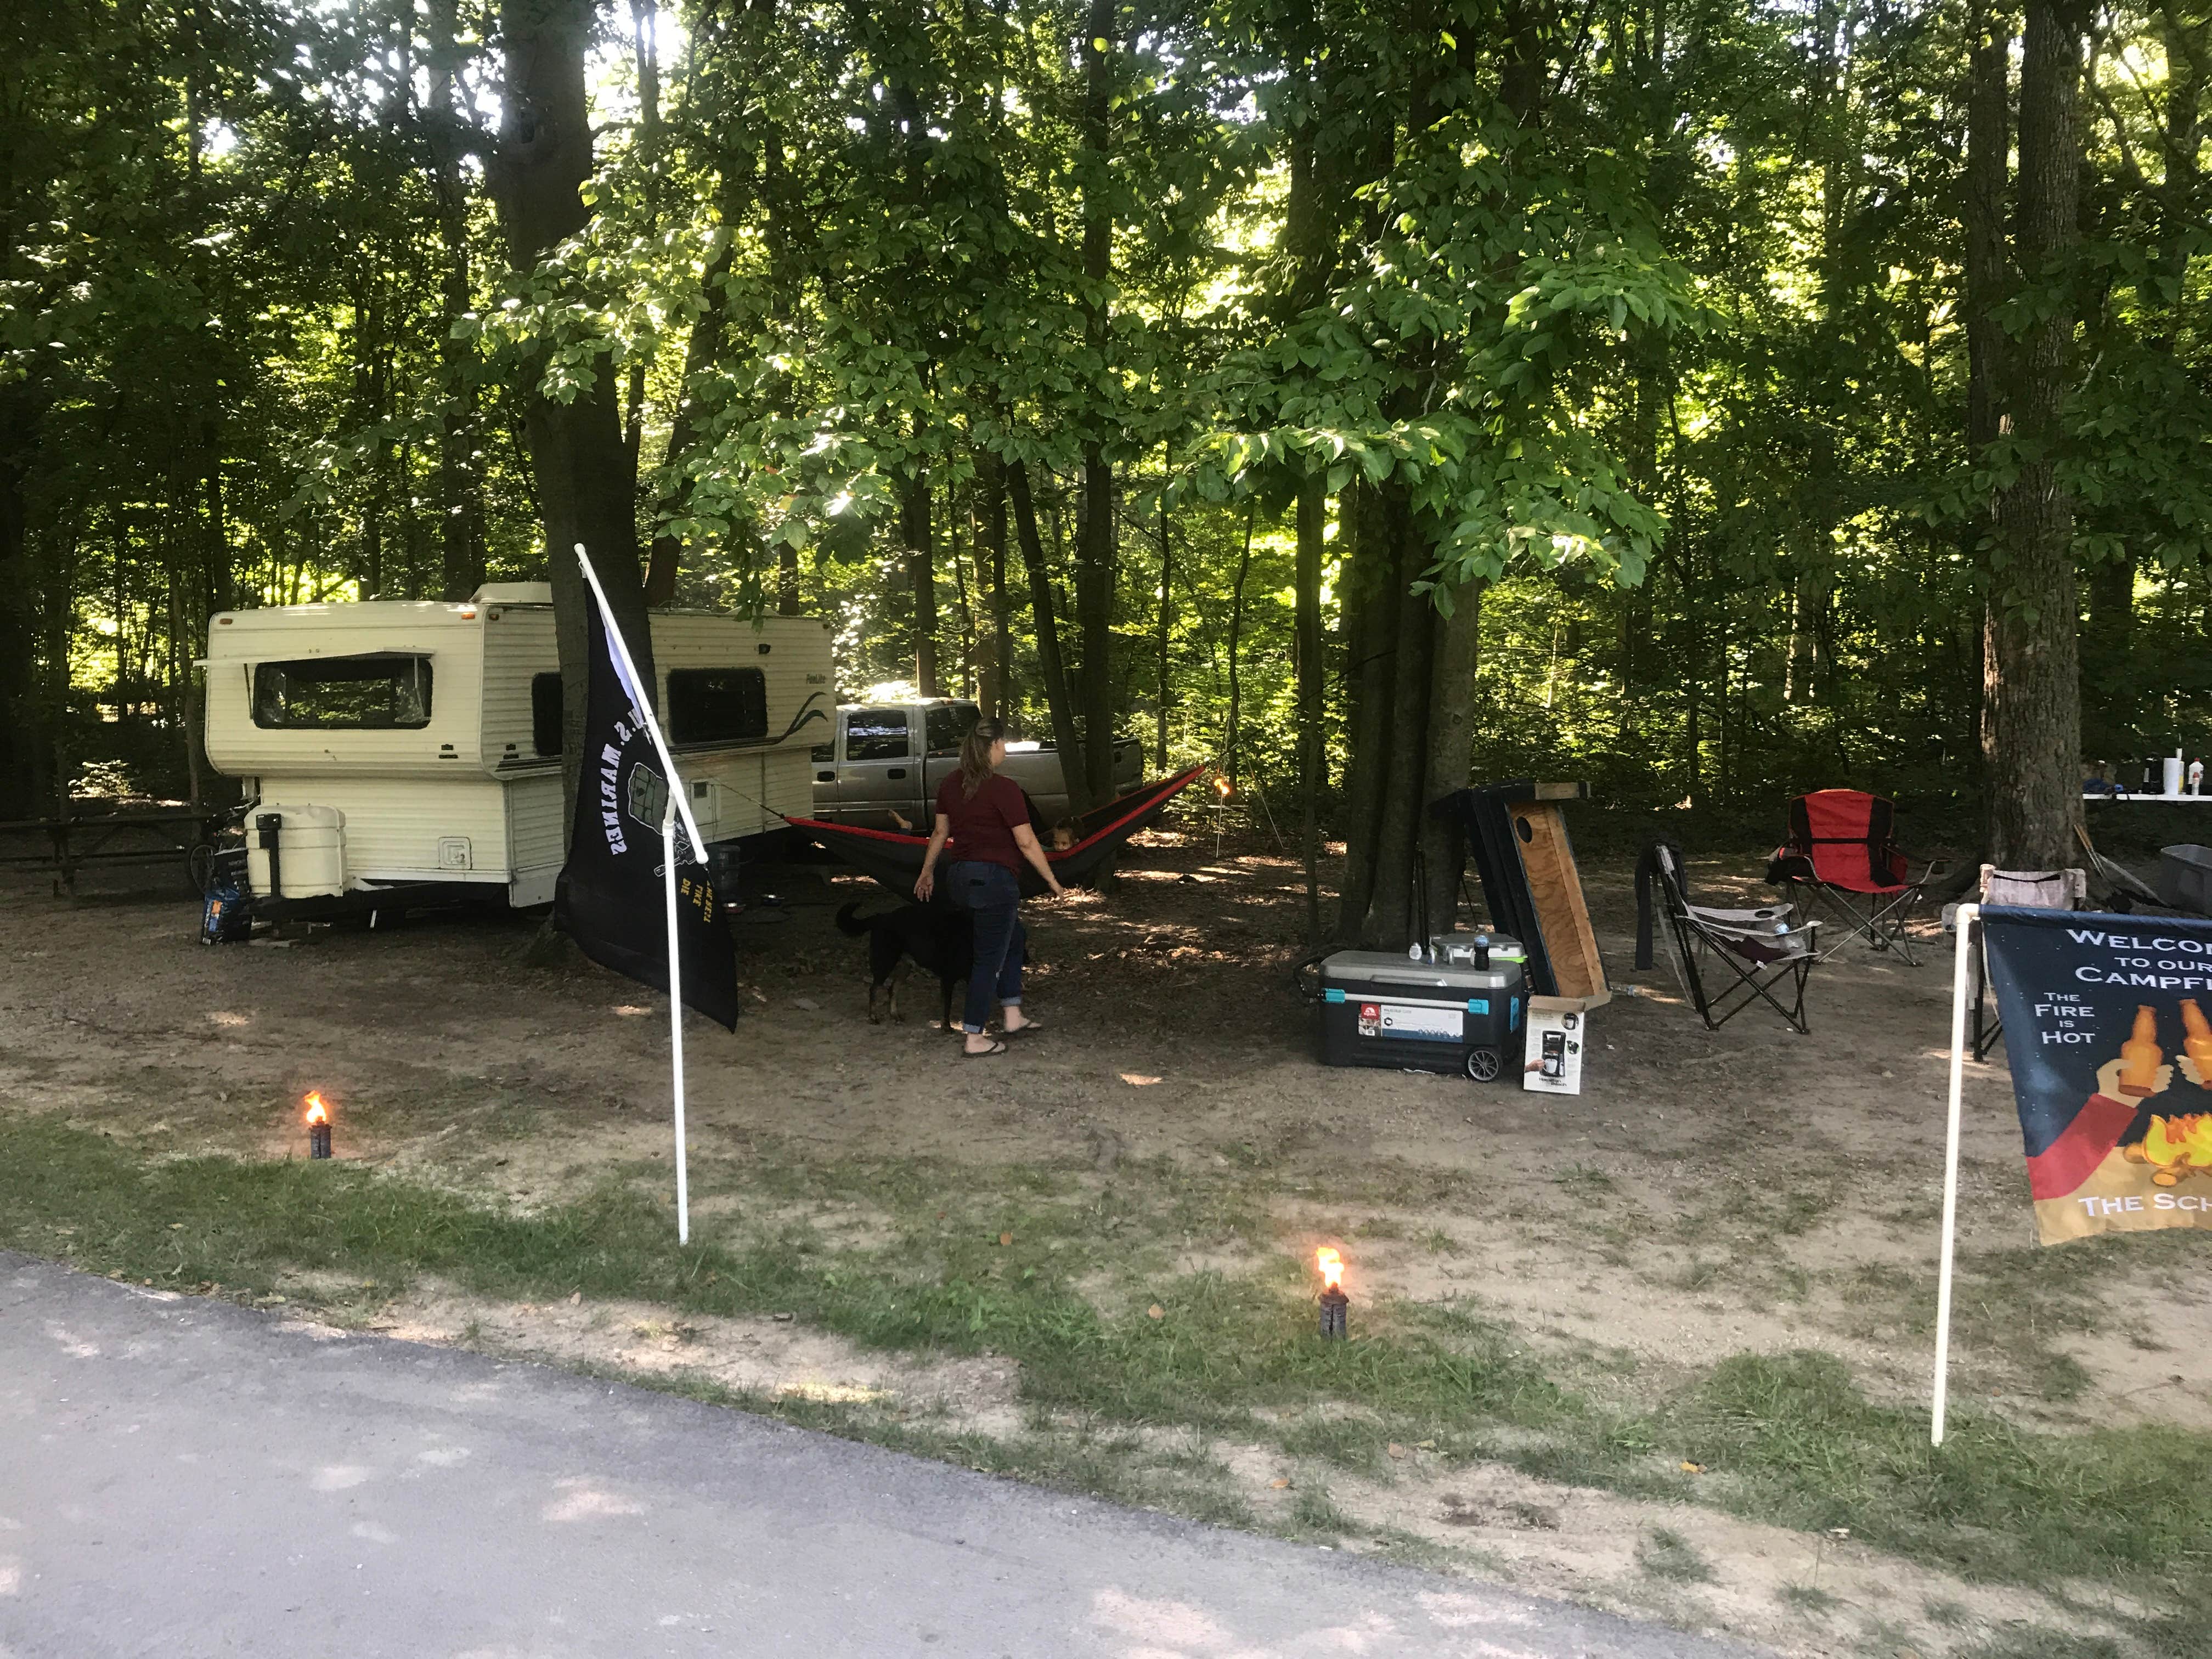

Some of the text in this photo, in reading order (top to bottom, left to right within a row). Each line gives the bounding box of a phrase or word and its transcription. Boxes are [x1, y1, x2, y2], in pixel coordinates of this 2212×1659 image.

[2114, 957, 2212, 973] TO OUR
[2044, 992, 2080, 1002] THE
[2034, 1004, 2095, 1017] FIRE
[2041, 1031, 2096, 1044] HOT
[2078, 1195, 2144, 1216] THE
